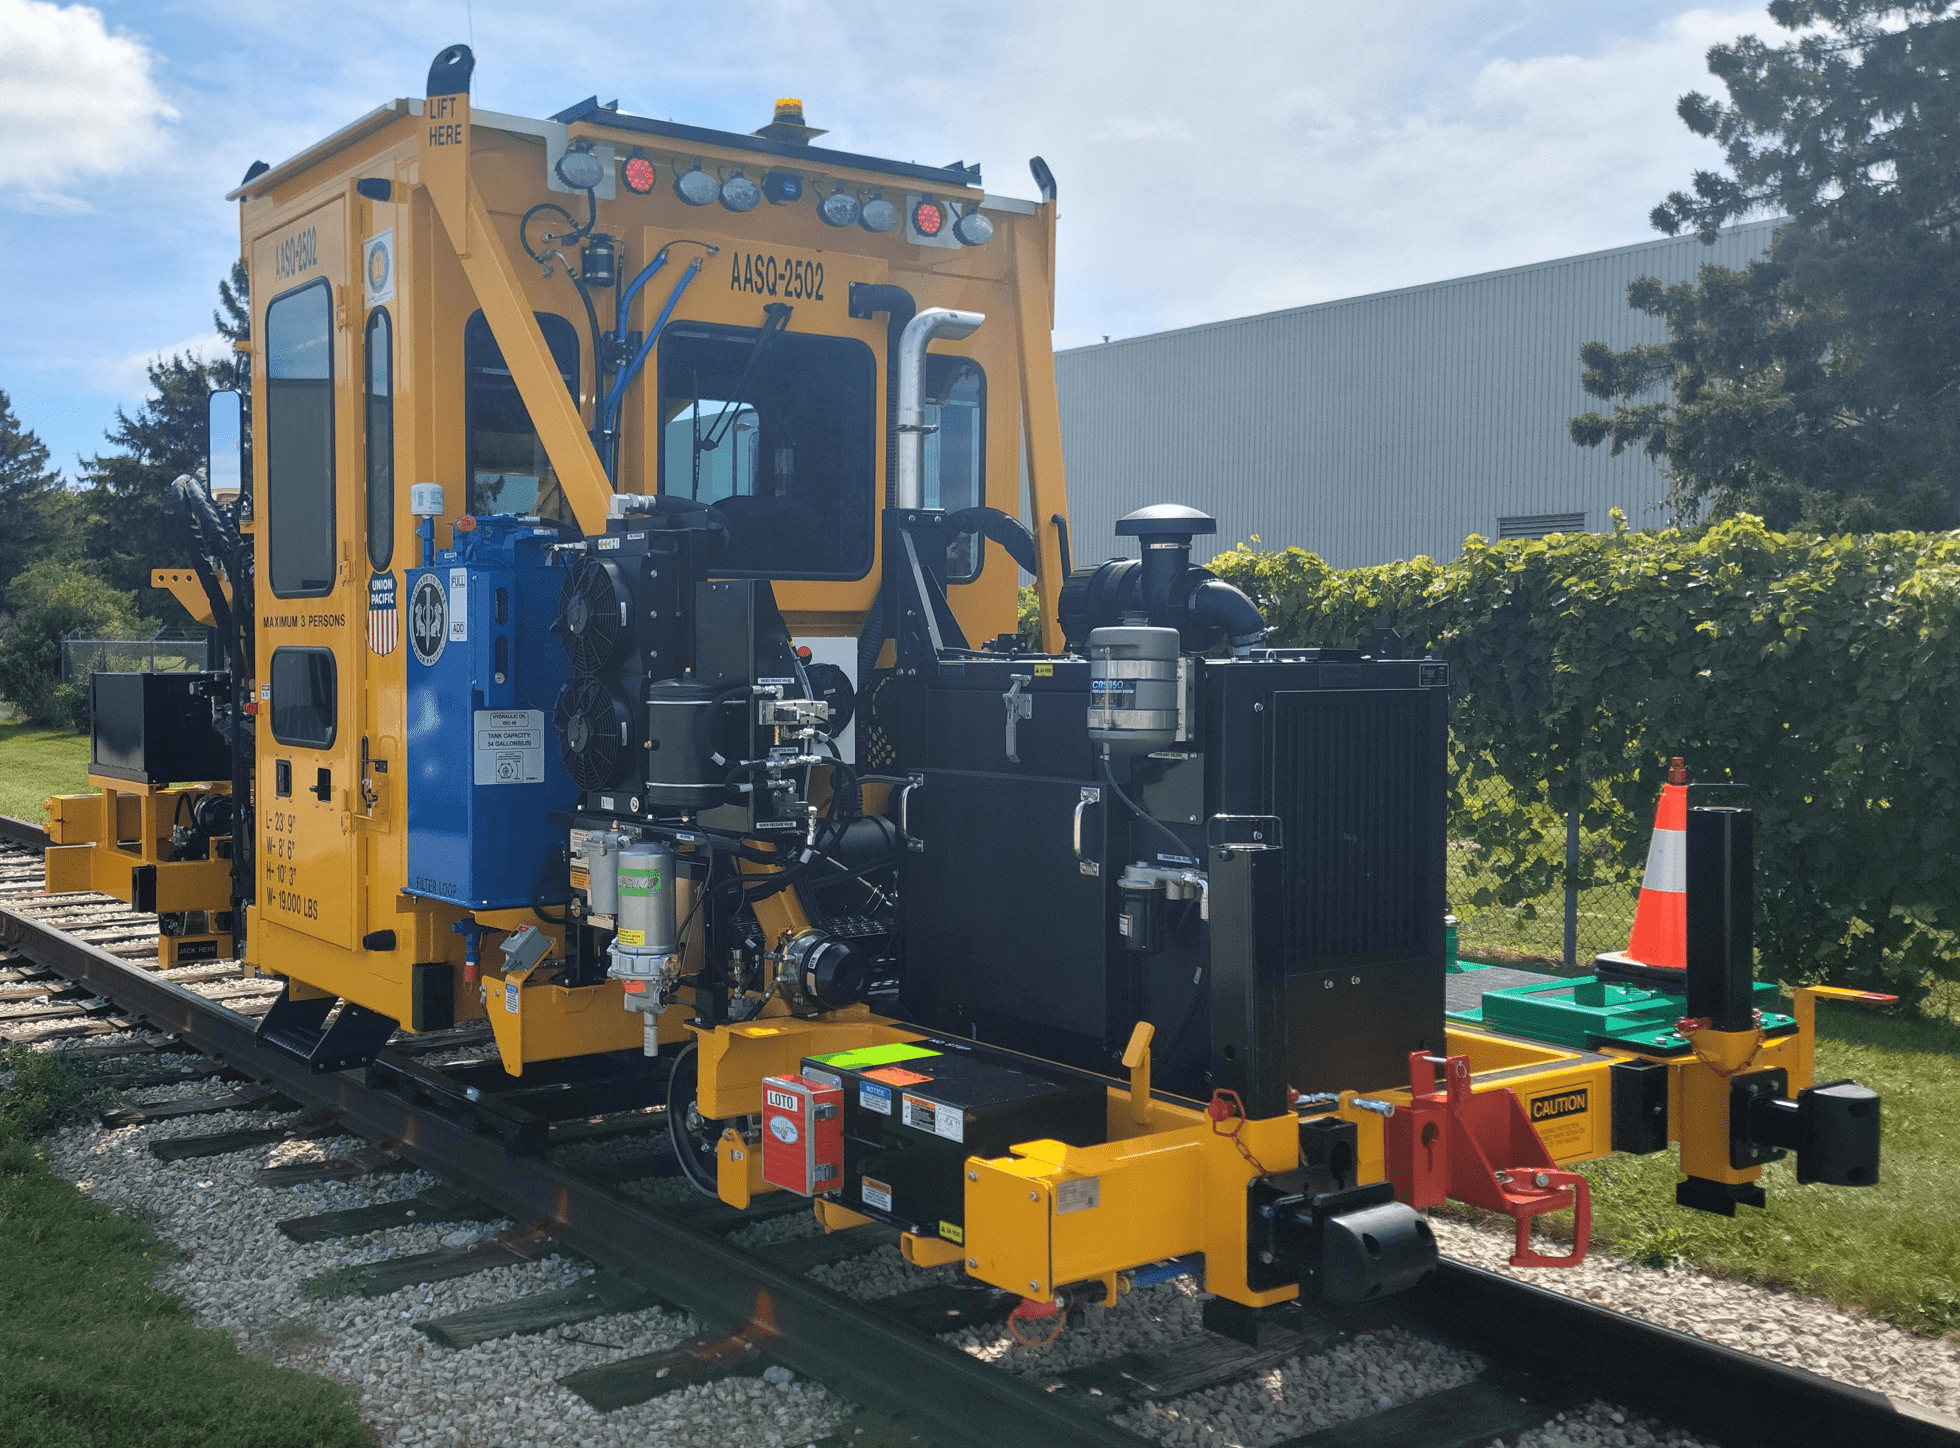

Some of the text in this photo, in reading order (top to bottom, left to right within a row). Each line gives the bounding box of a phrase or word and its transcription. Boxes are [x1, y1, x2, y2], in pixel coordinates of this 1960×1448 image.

[430, 98, 456, 119] LIFT
[429, 124, 462, 147] HERE
[275, 226, 317, 282] AASQ-2502
[731, 252, 824, 301] AASQ-2502
[372, 579, 393, 591] UNION
[452, 577, 465, 587] FULL
[371, 593, 394, 605] PACIFIC
[263, 613, 346, 628] MAXIMUM 3 PERSONS
[453, 623, 465, 633] ADD
[266, 836, 276, 855] W-
[266, 861, 274, 880] H-
[266, 886, 276, 906] W-
[304, 897, 318, 920] LBS
[199, 945, 216, 953] HERE
[769, 1091, 794, 1110] LOTO
[866, 1085, 885, 1097] NOTICE
[1533, 1094, 1586, 1118] CAUTION
